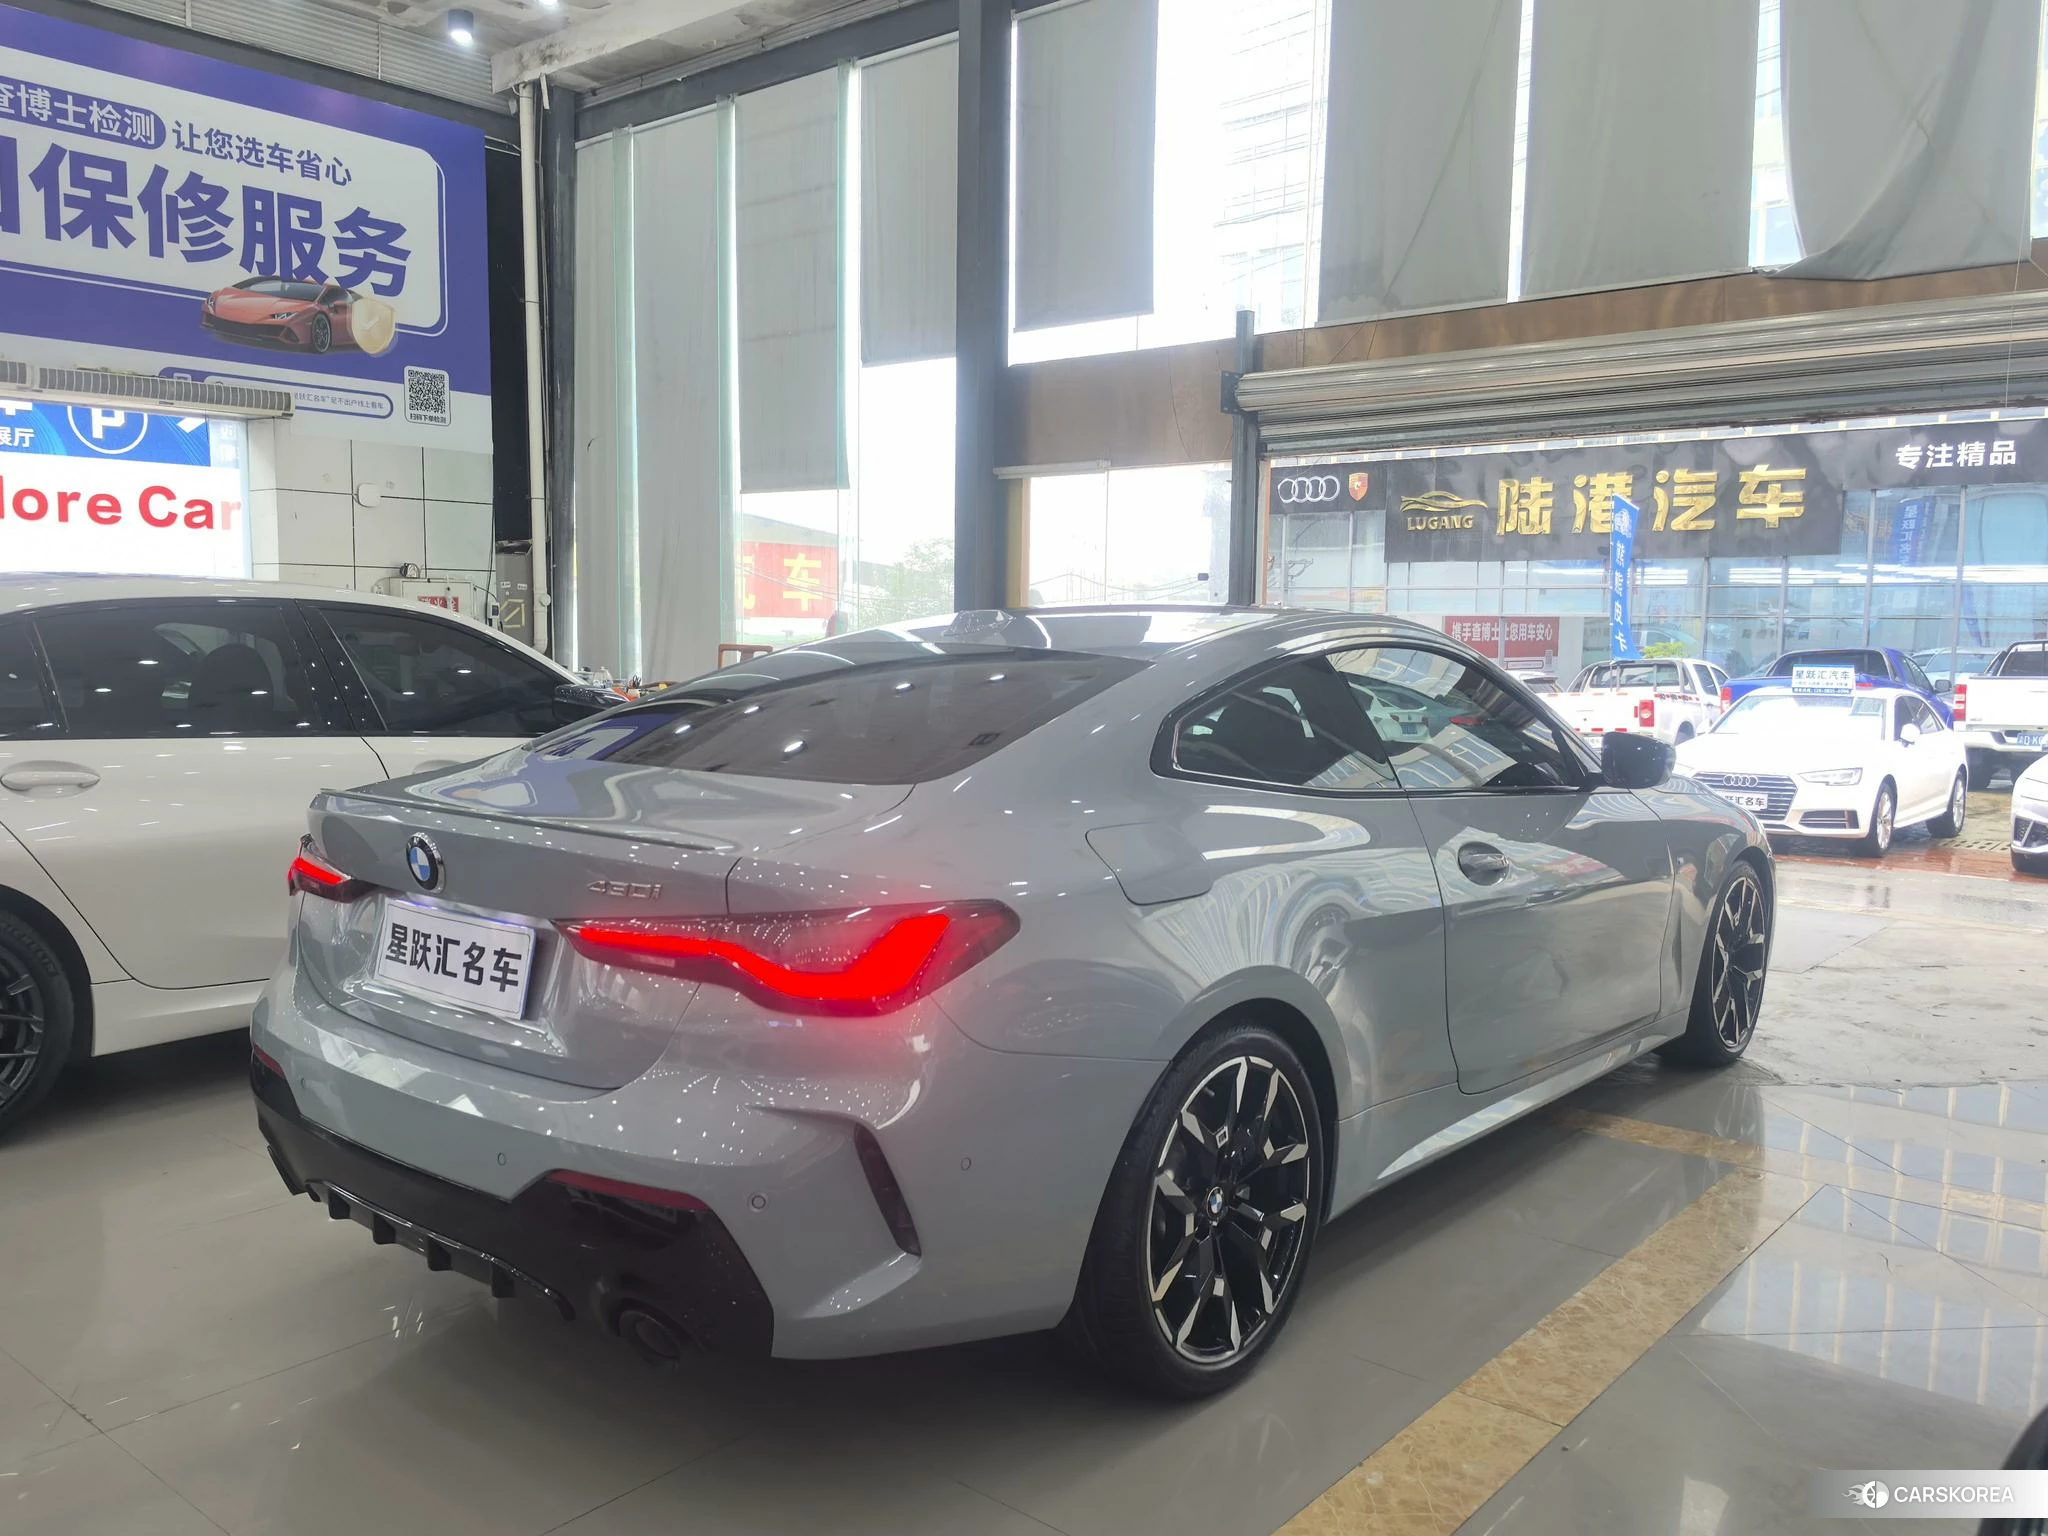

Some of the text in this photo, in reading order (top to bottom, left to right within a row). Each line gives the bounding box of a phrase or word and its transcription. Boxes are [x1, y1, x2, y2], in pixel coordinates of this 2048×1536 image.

[172, 120, 352, 187] 让您选车省心
[0, 135, 412, 298] 保修服务
[1895, 440, 2017, 470] 专注精品
[0, 475, 122, 525] ore
[1407, 515, 1474, 531] LUGANG
[1496, 463, 1806, 536] 陆港汽车
[1795, 669, 1851, 680] 星跃汇汽车
[385, 922, 522, 993] 星跃汇名车
